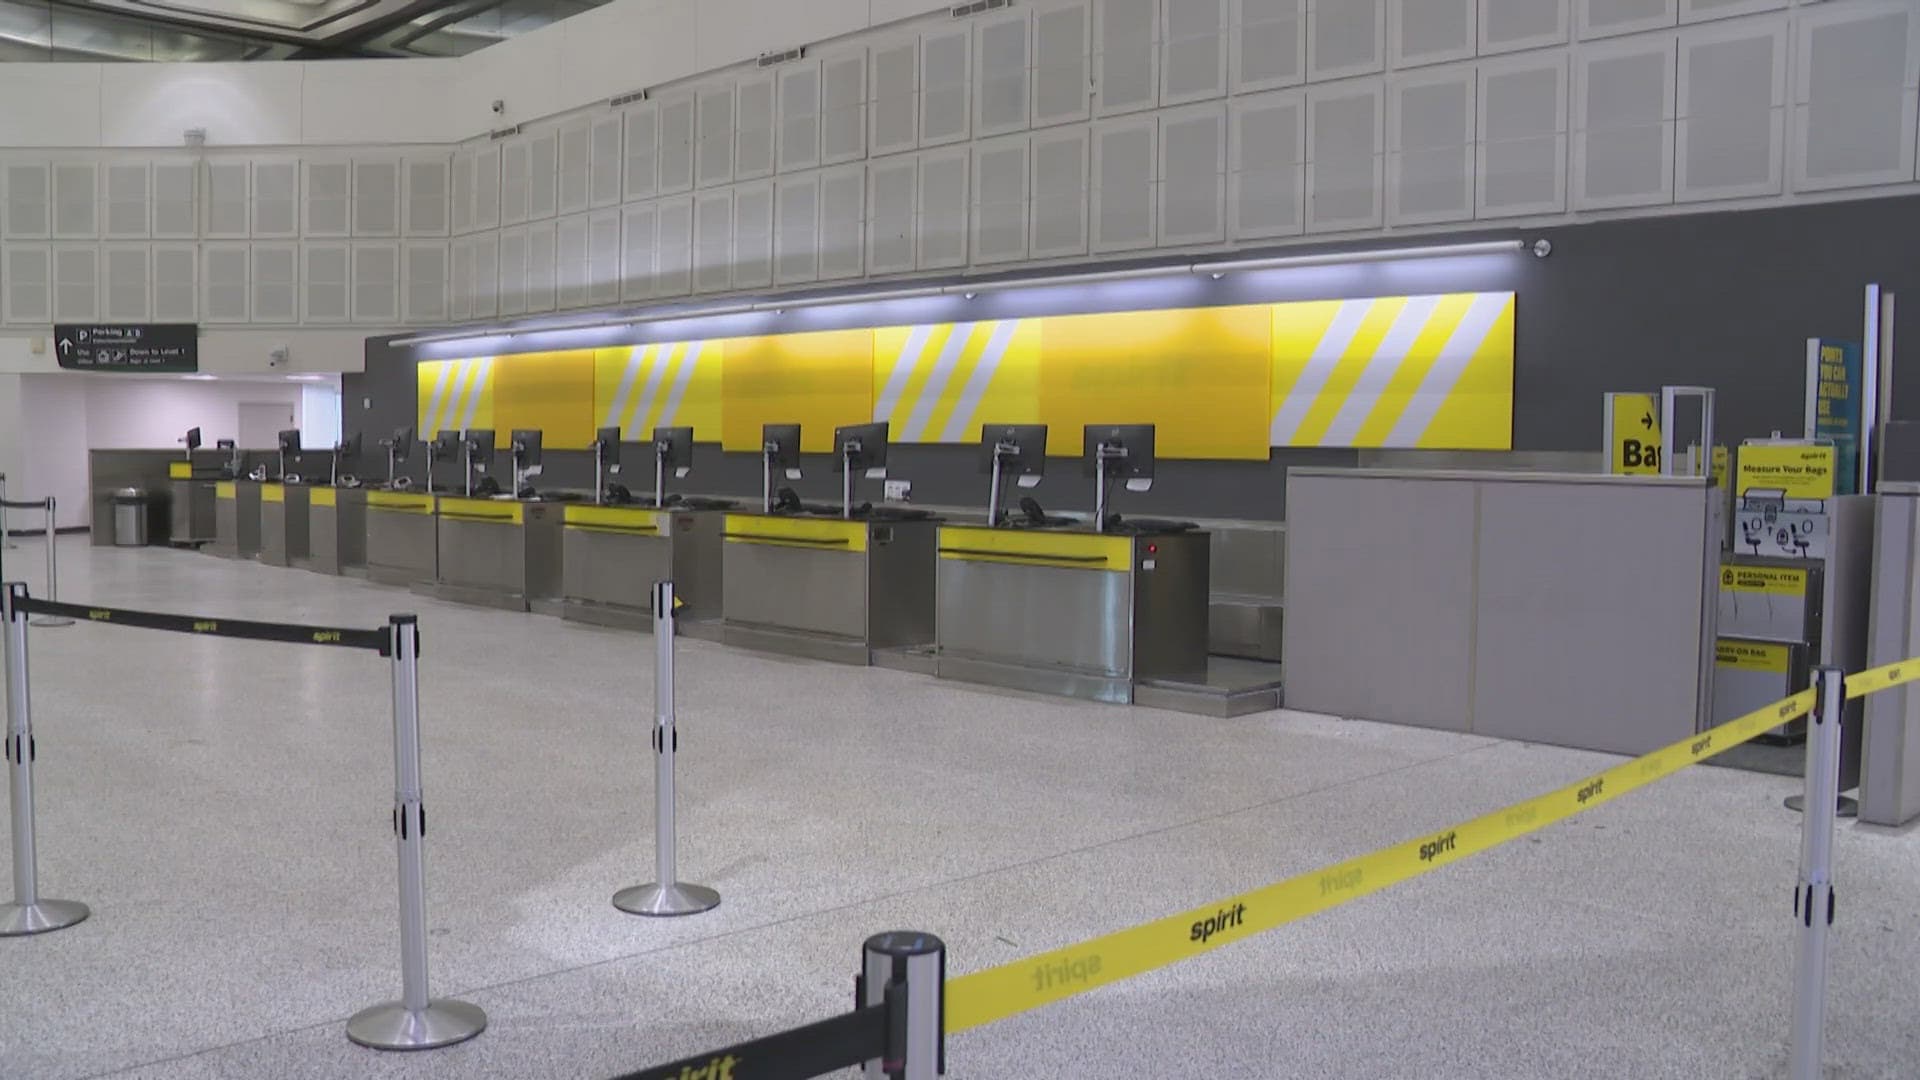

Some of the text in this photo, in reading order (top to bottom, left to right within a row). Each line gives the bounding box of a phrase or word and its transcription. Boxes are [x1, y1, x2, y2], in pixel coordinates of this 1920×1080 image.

[93, 328, 123, 337] Parking
[1623, 439, 1661, 473] Ba
[1743, 464, 1827, 476] Measure Your Bags
[1737, 571, 1800, 582] PERSONAL ITEM
[89, 609, 111, 620] spirit
[193, 621, 217, 632] spirit
[313, 631, 340, 643] spirit
[1577, 778, 1604, 804] spirit
[1419, 831, 1457, 862] spirit
[1190, 903, 1246, 943] spirit
